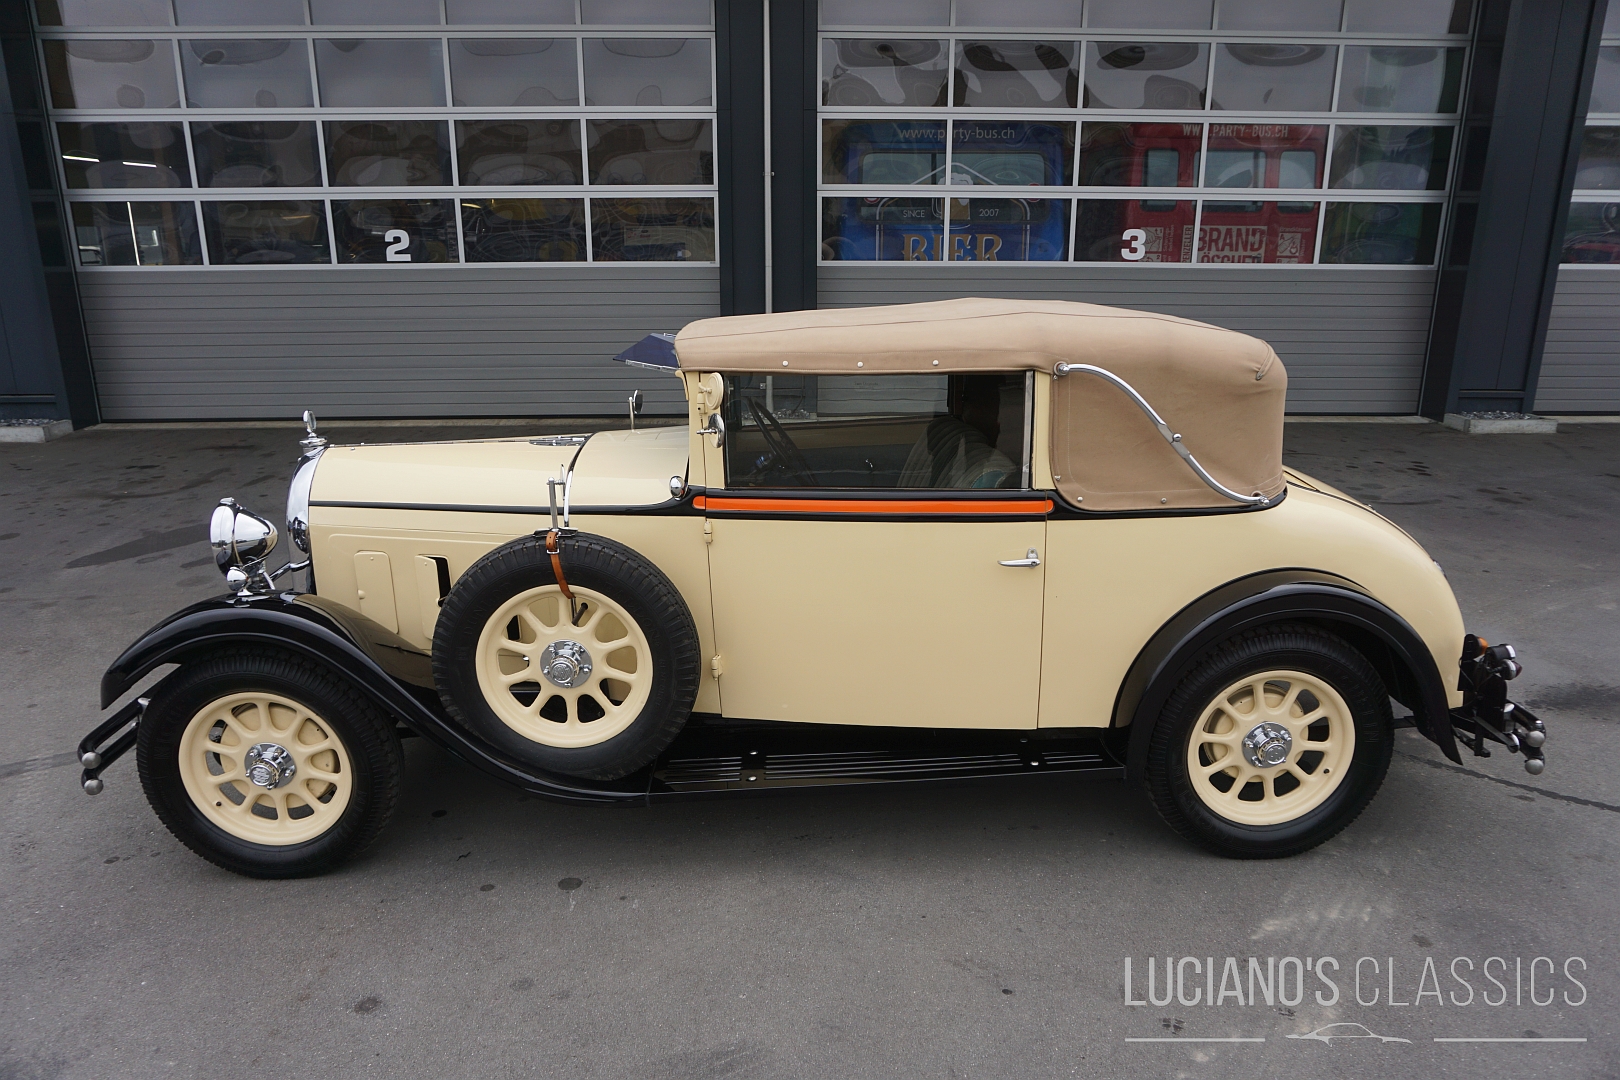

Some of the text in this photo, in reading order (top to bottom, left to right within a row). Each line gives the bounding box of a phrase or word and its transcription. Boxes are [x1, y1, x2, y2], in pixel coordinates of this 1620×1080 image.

[900, 127, 1015, 141] www.prty-bus.ch
[1182, 124, 1289, 138] WW.PARTY-BUS.CH
[903, 208, 1000, 218] SINCE 2007
[385, 230, 411, 261] 2
[1121, 229, 1146, 260] 3
[1197, 227, 1266, 252] BRAND
